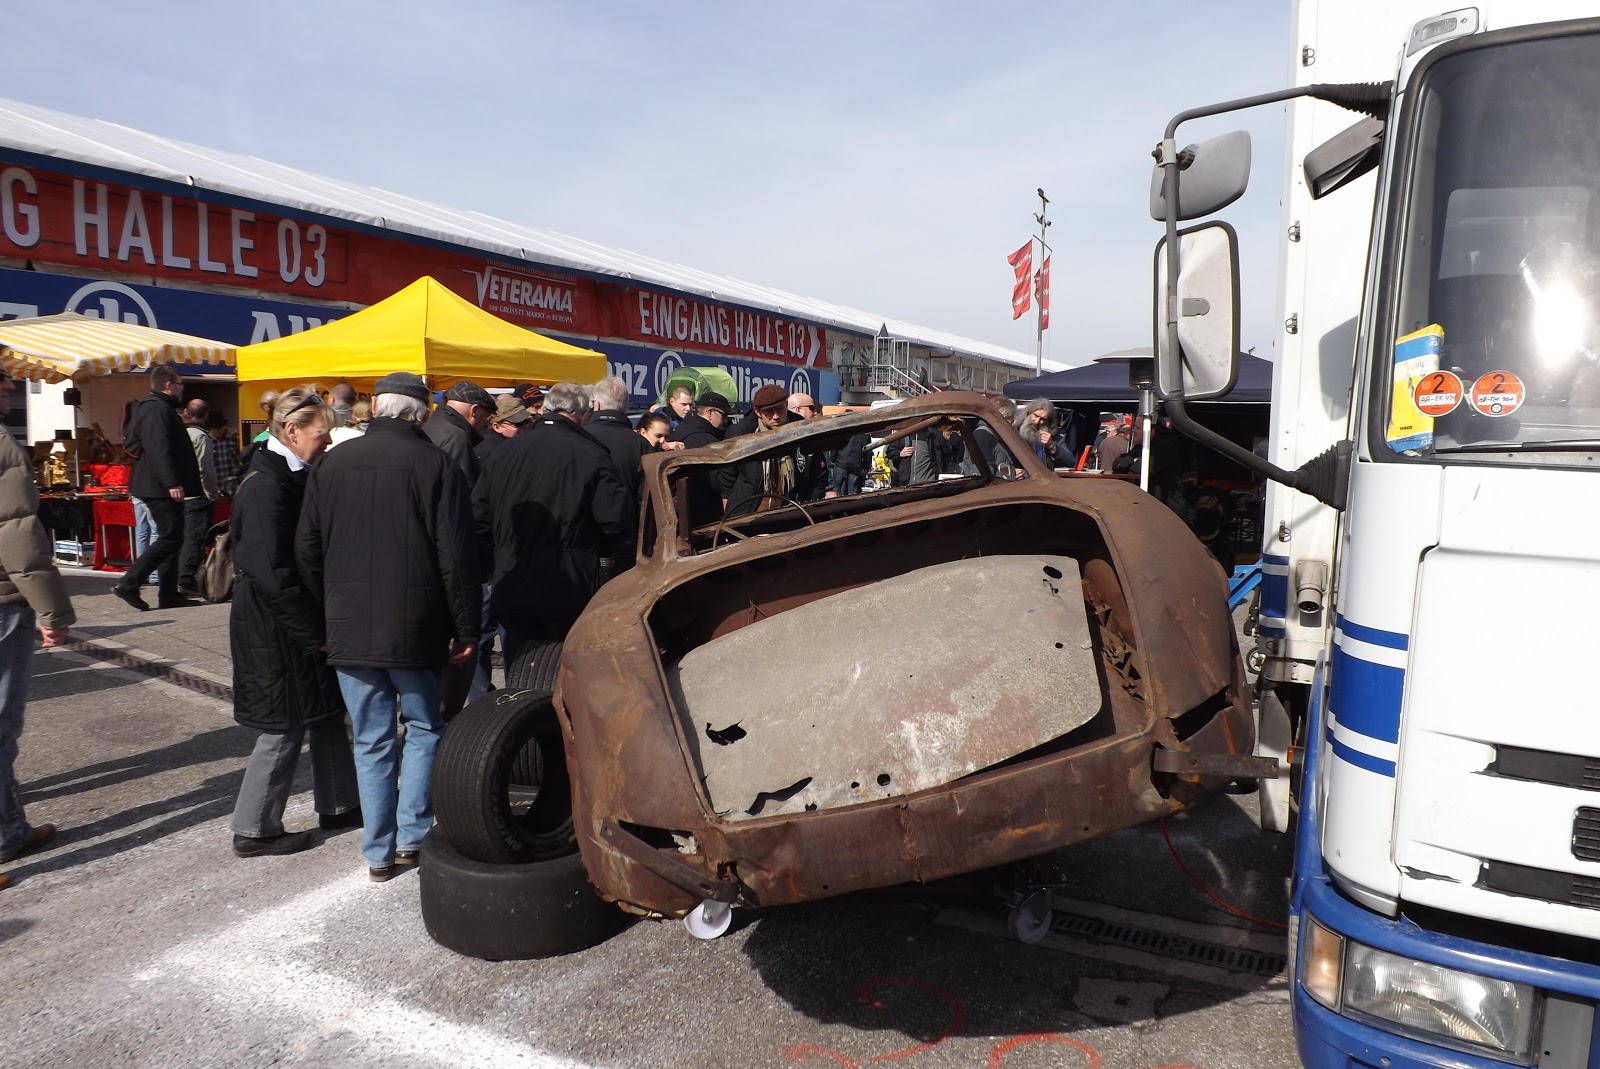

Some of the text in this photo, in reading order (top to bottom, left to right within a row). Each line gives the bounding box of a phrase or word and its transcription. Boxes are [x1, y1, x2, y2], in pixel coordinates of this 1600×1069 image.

[73, 179, 260, 278] HALLE
[277, 218, 328, 288] 03
[462, 265, 573, 313] VETERAMA
[526, 310, 546, 319] MARKT
[552, 314, 573, 323] EUROPA
[638, 290, 806, 359] EINGANG HALLE 03
[1432, 373, 1445, 393] 2
[1491, 373, 1505, 393] 2
